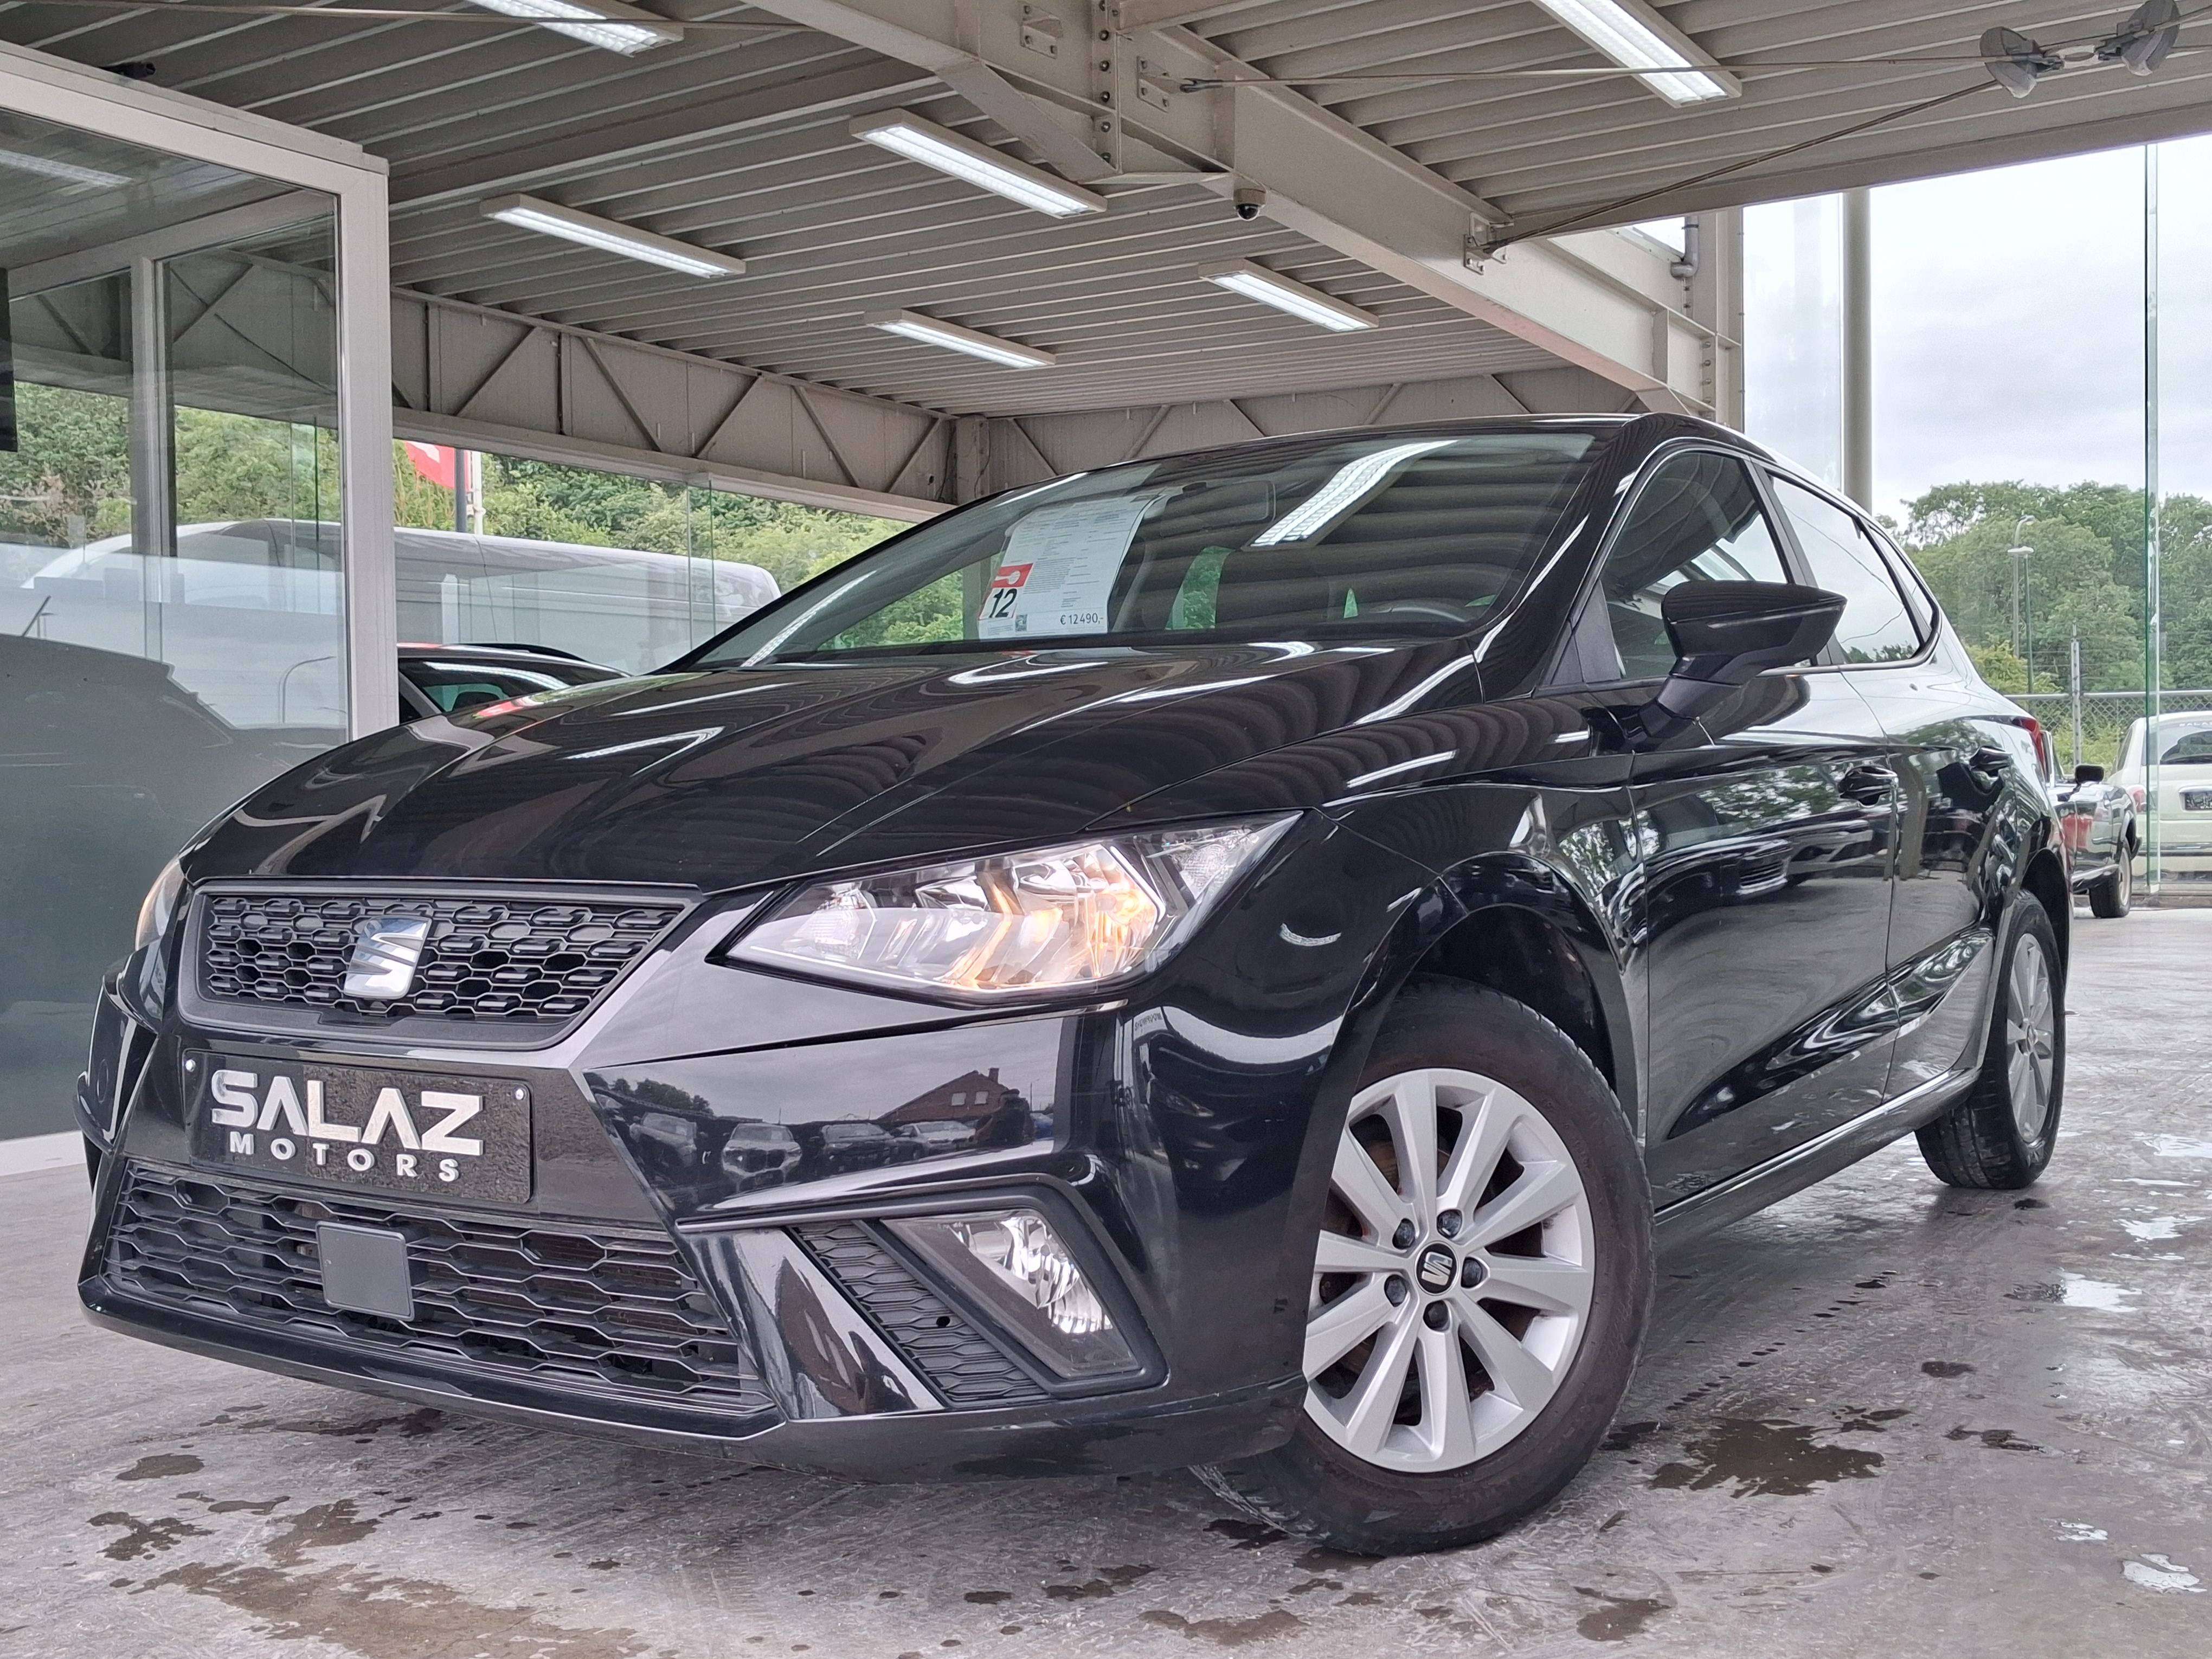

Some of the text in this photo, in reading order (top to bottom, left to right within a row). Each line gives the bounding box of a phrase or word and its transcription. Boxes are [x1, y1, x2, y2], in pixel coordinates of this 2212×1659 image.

[989, 588, 1018, 619] 12
[211, 1069, 483, 1156] SALAZ
[229, 1131, 459, 1182] MOTORS
